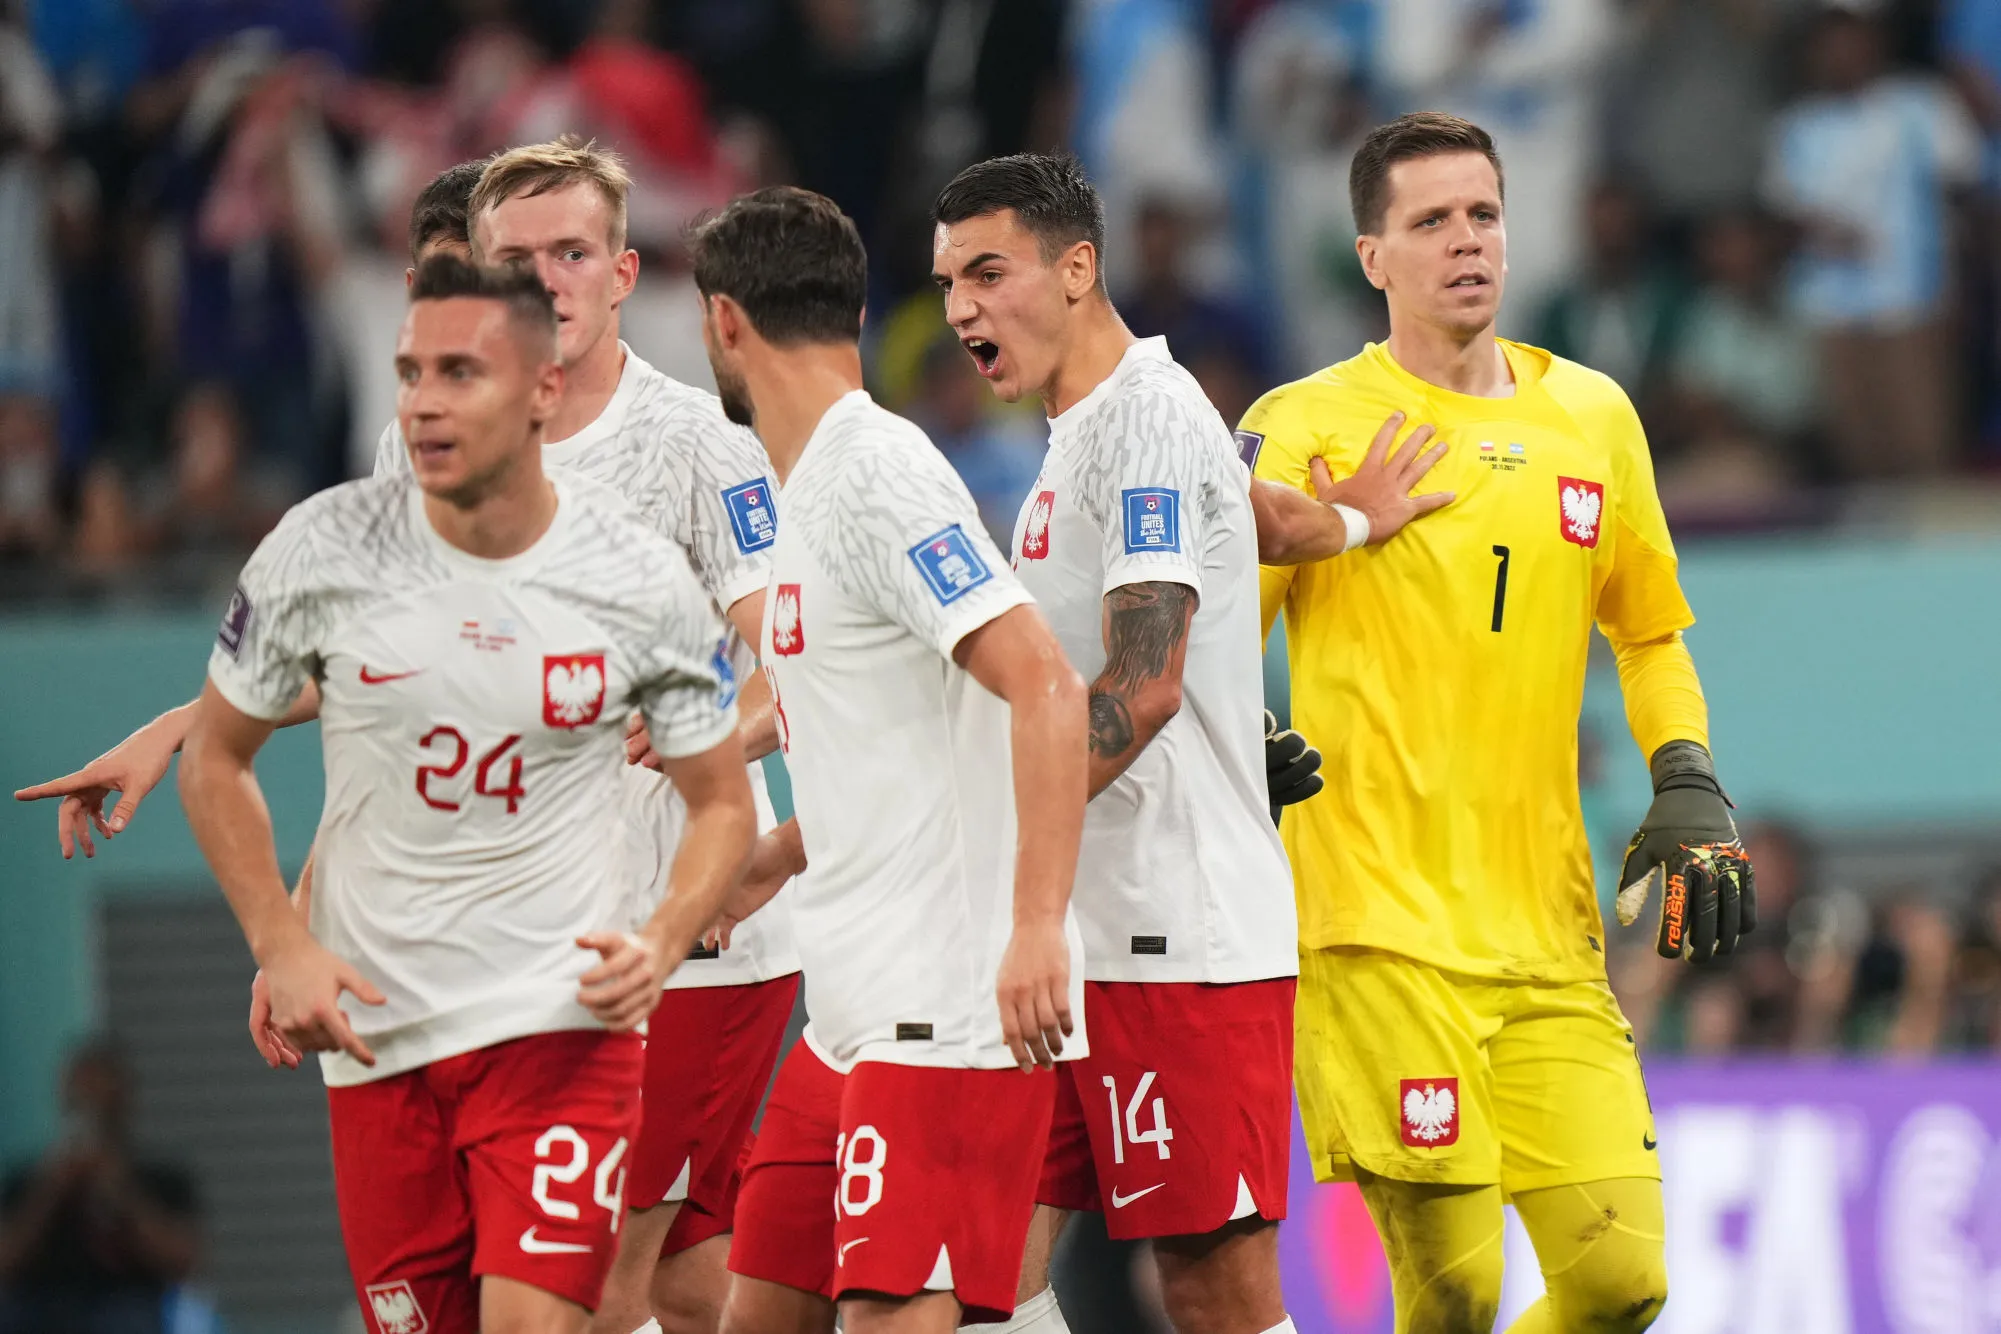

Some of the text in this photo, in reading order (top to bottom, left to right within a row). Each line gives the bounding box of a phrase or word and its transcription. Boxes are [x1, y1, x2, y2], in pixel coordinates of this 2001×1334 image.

[1141, 520, 1164, 529] UNITES
[1491, 545, 1510, 632] 1
[416, 724, 525, 814] 24
[1665, 873, 1687, 949] reusch
[1102, 1071, 1174, 1164] 14
[532, 1124, 629, 1234] 24
